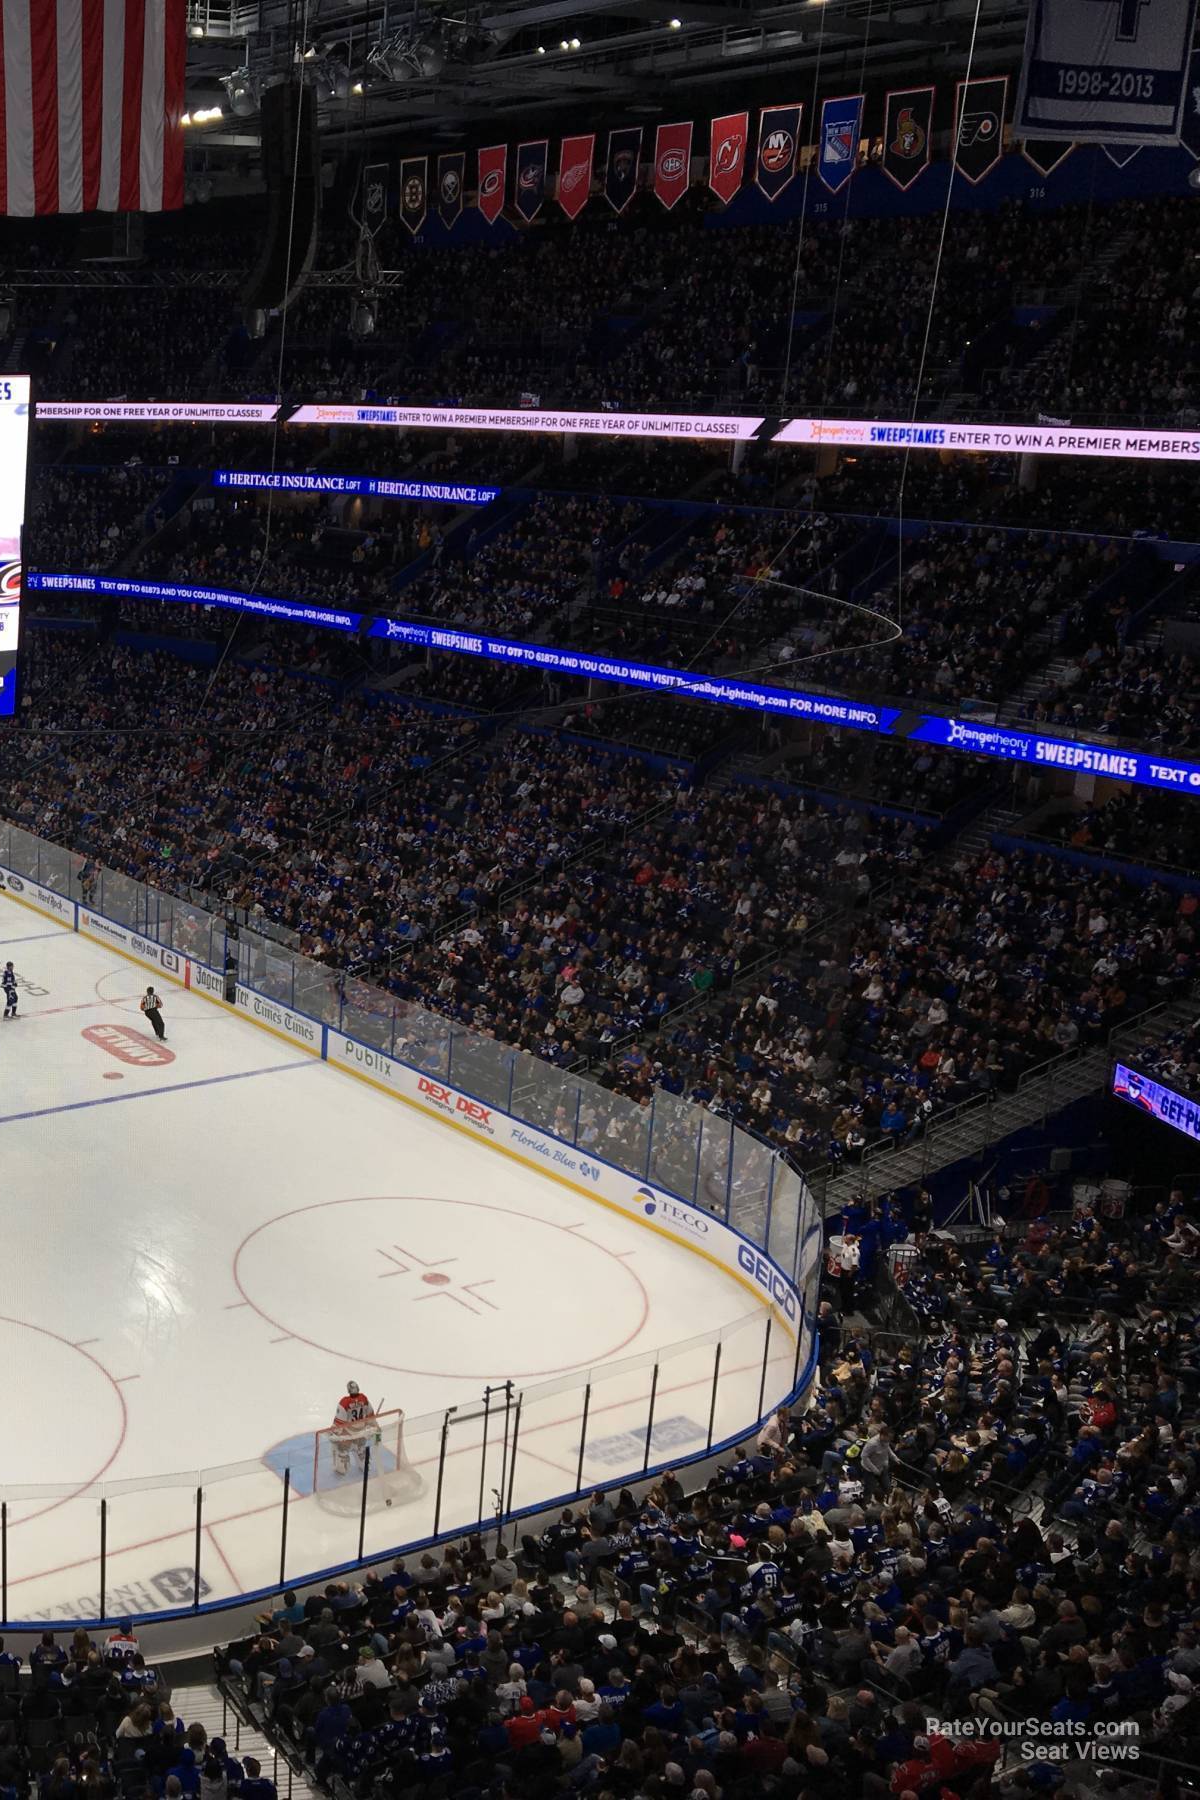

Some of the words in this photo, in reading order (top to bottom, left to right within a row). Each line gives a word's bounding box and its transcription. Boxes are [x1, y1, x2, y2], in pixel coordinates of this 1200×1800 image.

[1057, 69, 1155, 98] 1998-2013
[84, 407, 101, 416] FOR
[103, 407, 121, 416] ONE
[123, 408, 144, 416] FREE
[147, 408, 169, 416] YEAR
[172, 408, 183, 416] OF
[184, 408, 225, 417] UNLIMITED
[226, 409, 262, 417] CLASSES!
[357, 410, 397, 421] SWEEPSTAKES
[399, 413, 421, 422] ENTER
[422, 413, 432, 422] TO
[432, 413, 447, 423] WIN
[455, 414, 487, 424] PREMIER
[489, 415, 539, 426] MEMBERSHIP
[541, 418, 557, 427] FOR
[559, 418, 577, 428] ONE
[579, 419, 600, 428] FREE
[601, 420, 625, 429] YEAR
[627, 420, 640, 430] OF
[642, 421, 691, 432] UNLIMITED
[694, 423, 739, 434] CLASSES!
[870, 426, 946, 444] SWEEPSTAKES
[950, 432, 990, 445] ENTER
[994, 433, 1012, 446] TO
[1014, 434, 1043, 447] WIN
[1044, 435, 1055, 447] A
[1058, 436, 1122, 450] PREMIER
[229, 473, 280, 488] HERITAGE
[282, 475, 344, 490] INSURANCE
[345, 480, 361, 491] LOFT
[377, 481, 421, 497] HERITAGE
[422, 484, 477, 502] INSURANCE
[477, 491, 496, 503] LOFT
[41, 576, 96, 590] SWEEPSTAKES
[100, 581, 117, 590] TEXT
[161, 587, 176, 596] AND
[177, 589, 192, 598] YOU
[193, 590, 216, 600] COULD
[304, 609, 317, 619] FOR
[431, 631, 483, 653] SWEEPSTAKES
[488, 643, 507, 655] TEXT
[524, 649, 535, 659] TO
[535, 651, 559, 664] 61873
[559, 656, 578, 668] AND
[579, 660, 598, 672] YOU
[598, 663, 629, 678] COULD
[652, 673, 676, 686] VISIT
[790, 698, 813, 713] FOR
[814, 702, 847, 719] MORE
[848, 708, 879, 725] INFO.
[1035, 740, 1138, 778] SWEEPSTAKES
[1150, 764, 1188, 784] TEXT
[253, 997, 282, 1025] Times
[284, 1012, 314, 1041] Times
[345, 1040, 392, 1076] Publix
[417, 1076, 453, 1105] DEX
[425, 1095, 455, 1115] imaging
[455, 1095, 493, 1125] DEX
[463, 1114, 495, 1135] imaging
[510, 1128, 551, 1157] Florida
[552, 1149, 577, 1170] Blue
[661, 1200, 709, 1233] TECO
[738, 1244, 796, 1322] GEICO
[763, 1574, 778, 1588] 91
